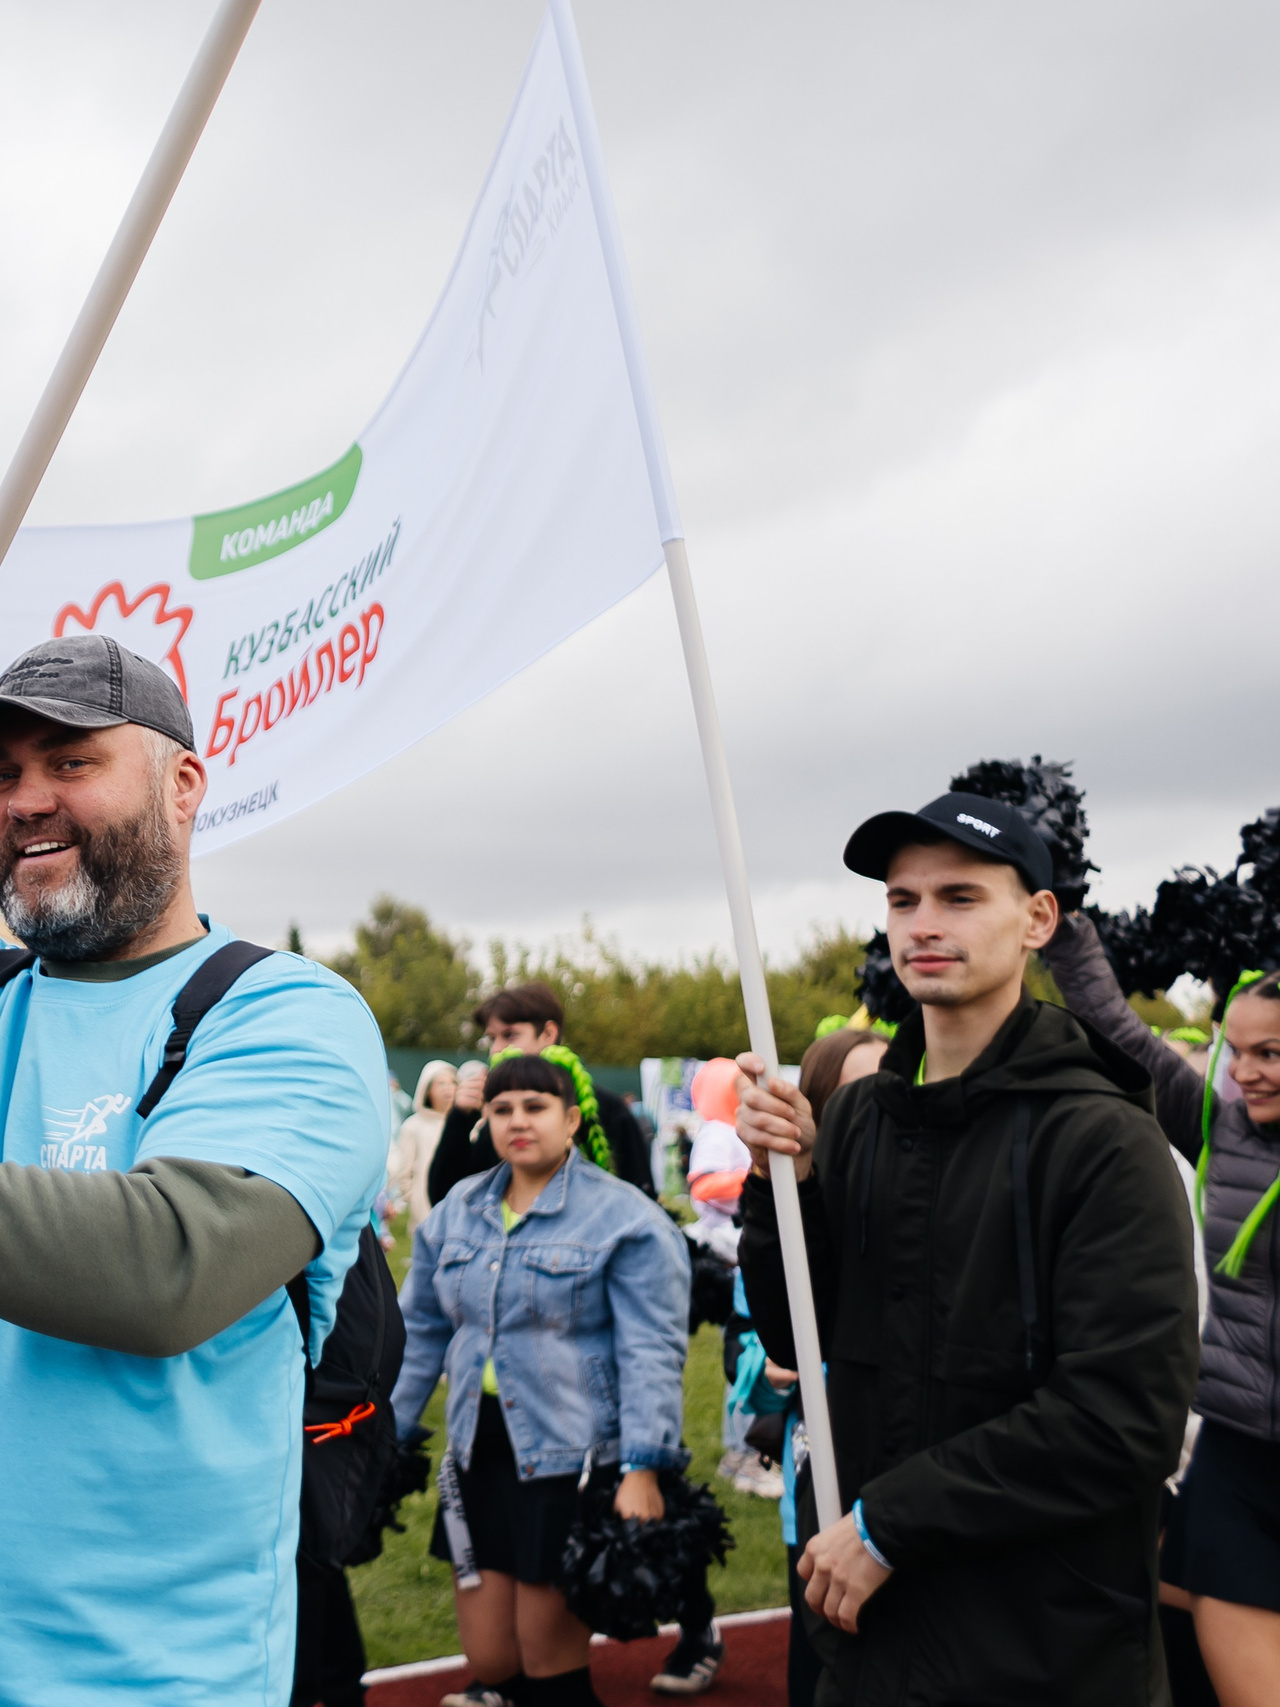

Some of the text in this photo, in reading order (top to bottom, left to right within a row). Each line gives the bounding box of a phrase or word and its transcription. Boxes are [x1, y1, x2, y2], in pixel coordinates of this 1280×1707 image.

[220, 491, 333, 561] КОМАНДА
[223, 515, 401, 679] КУЗБАССКИЙ
[205, 601, 385, 767] Бройлер
[194, 780, 279, 832] ОКУЗНЕЦК
[957, 813, 1001, 838] SPORT
[40, 1143, 107, 1171] СПАРТА
